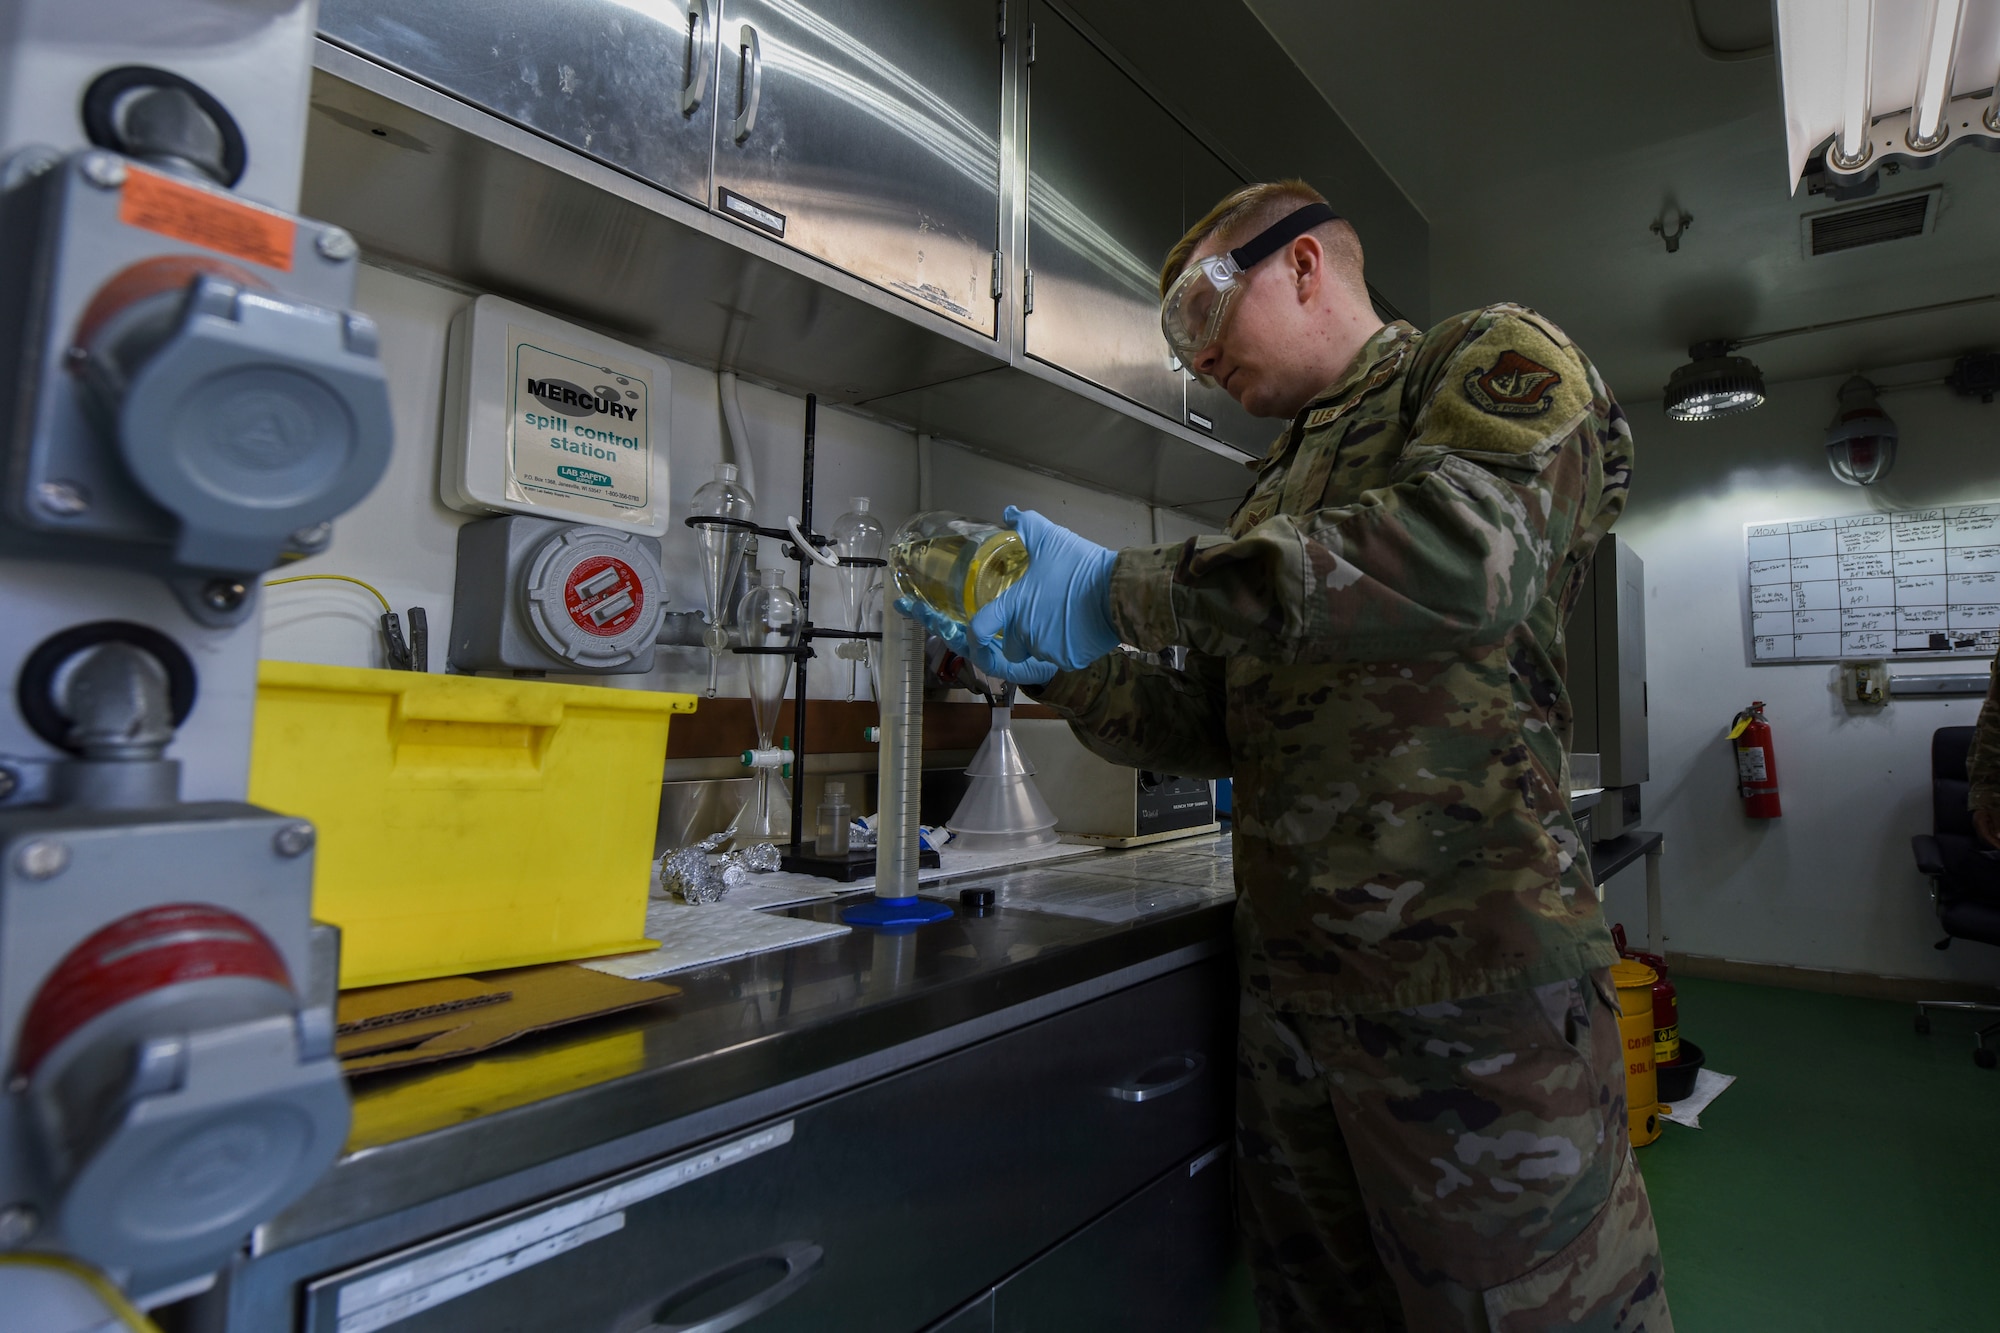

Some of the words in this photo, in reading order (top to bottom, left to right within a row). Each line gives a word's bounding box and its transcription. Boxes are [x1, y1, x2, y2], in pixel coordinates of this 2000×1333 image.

[527, 378, 638, 422] MERCURY
[525, 411, 567, 430] spill
[574, 425, 639, 450] control
[550, 436, 616, 462] station
[561, 467, 578, 477] LAB
[579, 470, 608, 483] SAFETY
[1897, 511, 1938, 522] THUR
[1957, 507, 1989, 518] FRI
[1792, 521, 1828, 532] TUES
[1846, 517, 1884, 527] WED
[1753, 527, 1778, 536] MON
[569, 595, 600, 614] Appleton
